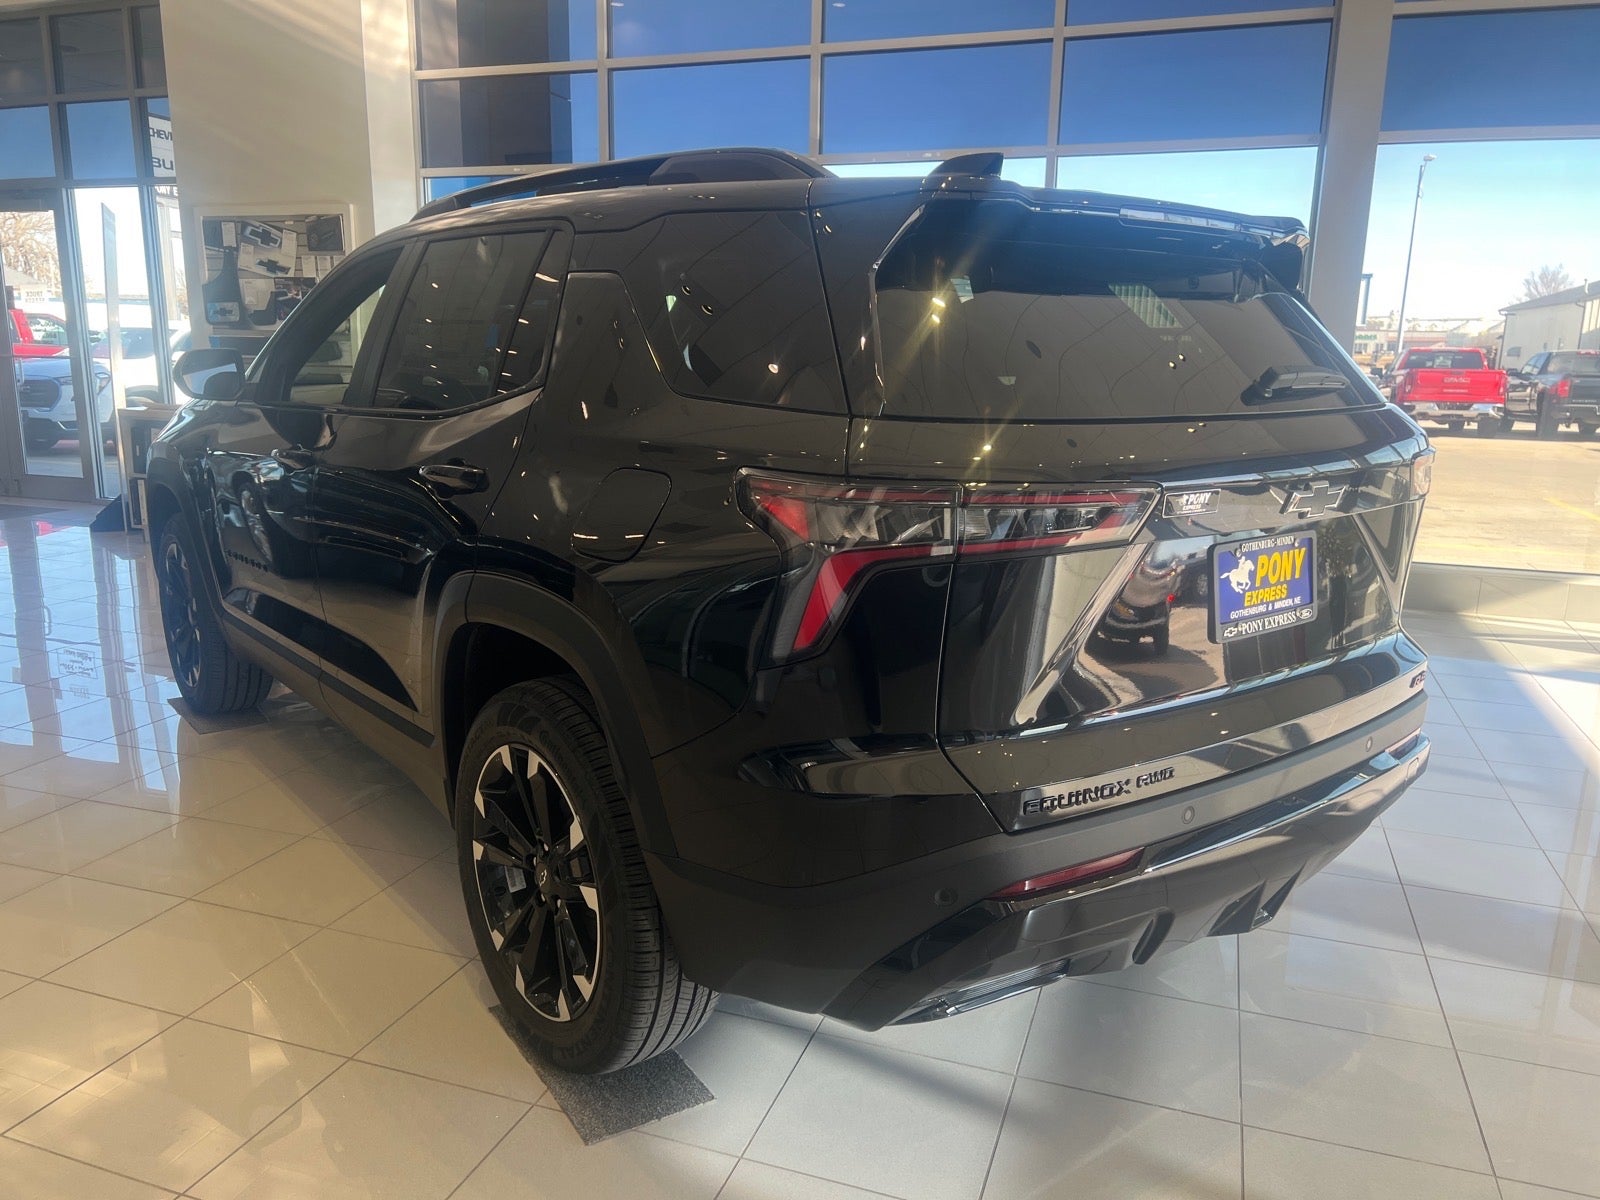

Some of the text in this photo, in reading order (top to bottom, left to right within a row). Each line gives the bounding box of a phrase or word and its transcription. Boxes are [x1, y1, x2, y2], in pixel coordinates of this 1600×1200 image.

[1255, 547, 1306, 587] PONY
[1230, 604, 1267, 619] GOTHENBURG
[1294, 596, 1302, 604] NE
[1244, 584, 1288, 607] EXPRESS
[1242, 611, 1297, 635] PONY EXPRESS
[1023, 778, 1133, 816] EQUINOX
